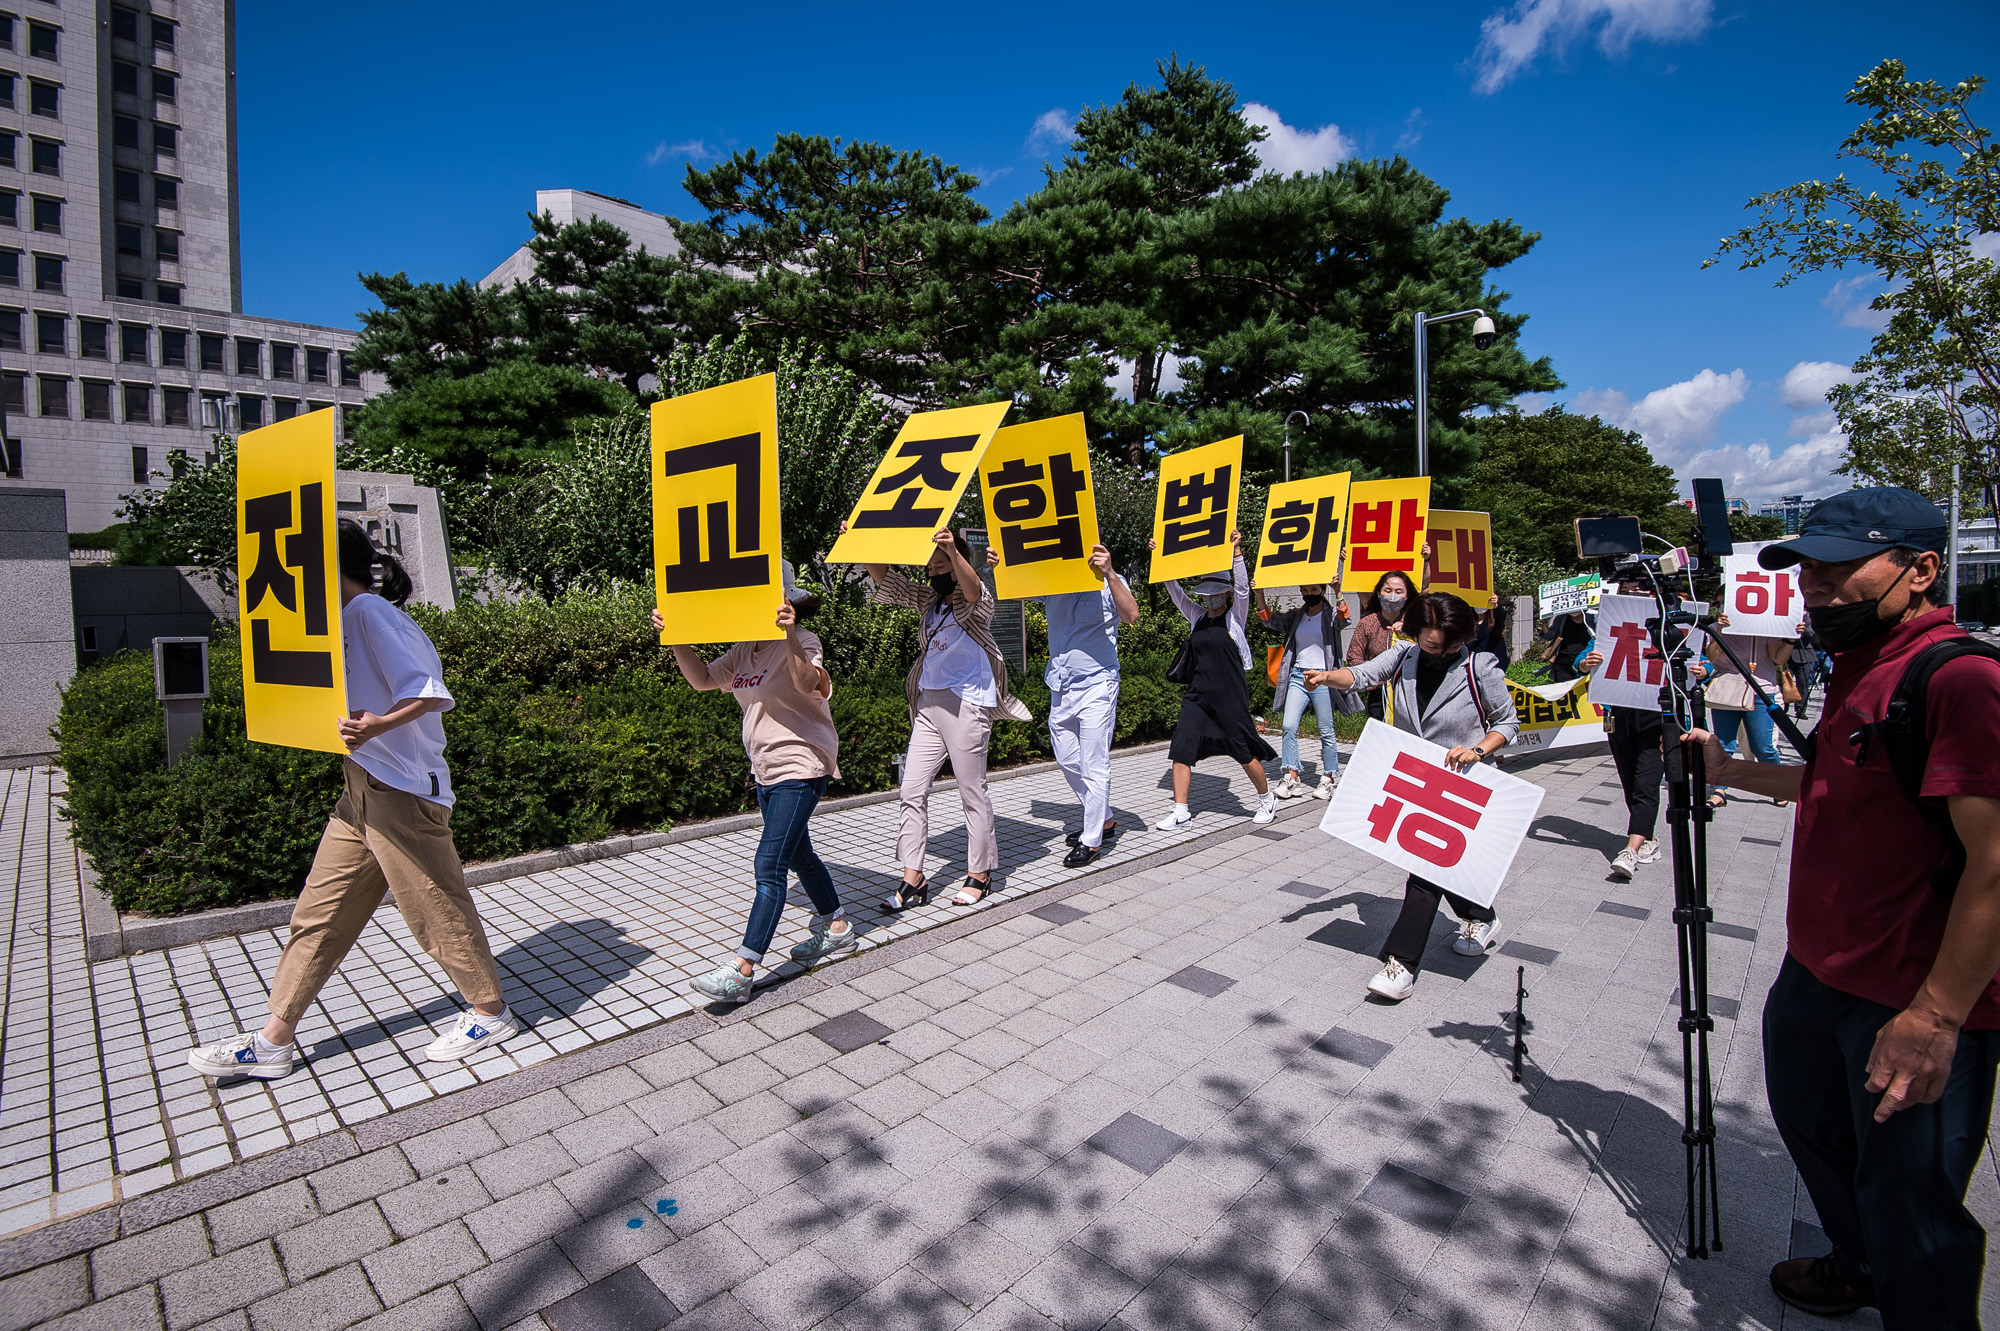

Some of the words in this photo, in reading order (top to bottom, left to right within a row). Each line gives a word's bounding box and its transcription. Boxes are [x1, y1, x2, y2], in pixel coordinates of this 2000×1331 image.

[665, 432, 770, 594] 교
[852, 434, 981, 529] 조
[987, 453, 1086, 567] 합
[1162, 465, 1231, 556] 법
[1261, 496, 1340, 568] 화
[1350, 498, 1425, 573] 반
[1426, 528, 1488, 591] 대
[244, 482, 334, 688] 전
[1735, 571, 1795, 617] 하
[1367, 751, 1493, 868] 행
